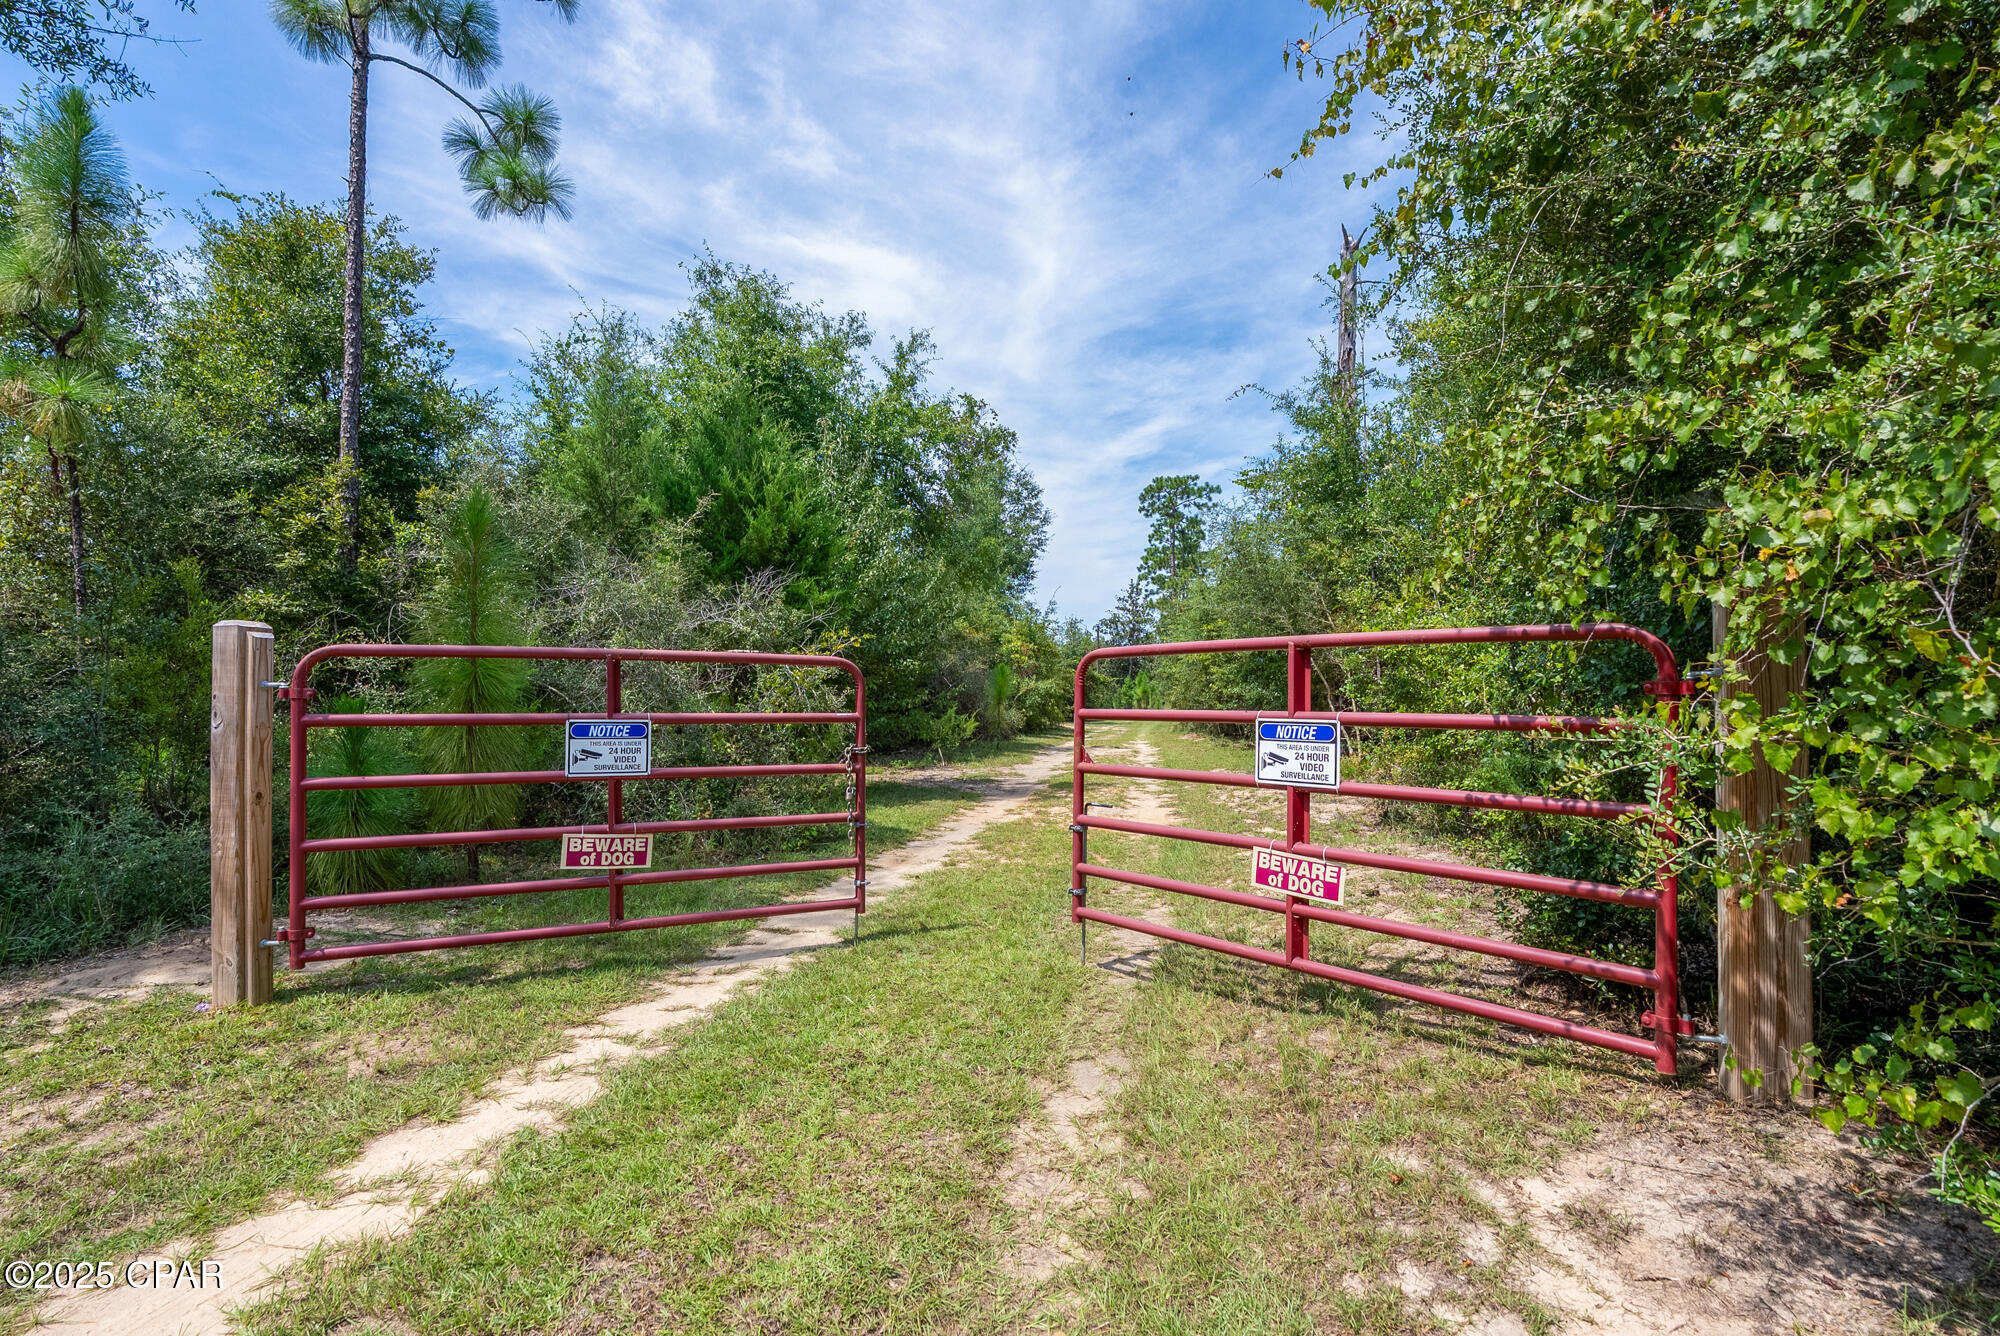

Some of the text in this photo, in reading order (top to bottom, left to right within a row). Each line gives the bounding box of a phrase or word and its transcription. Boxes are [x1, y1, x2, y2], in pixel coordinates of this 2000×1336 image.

[588, 725, 630, 736] NOTICE
[1276, 725, 1318, 740] NOTICE
[1294, 752, 1330, 762] 24 HOUR
[1300, 762, 1324, 772] VIDEO
[1280, 771, 1329, 782] SURVEILLANCE
[569, 838, 646, 852] BEWARE
[580, 852, 635, 865] of DOG
[1258, 852, 1339, 884] BEWARE
[1268, 873, 1324, 897] of DOG
